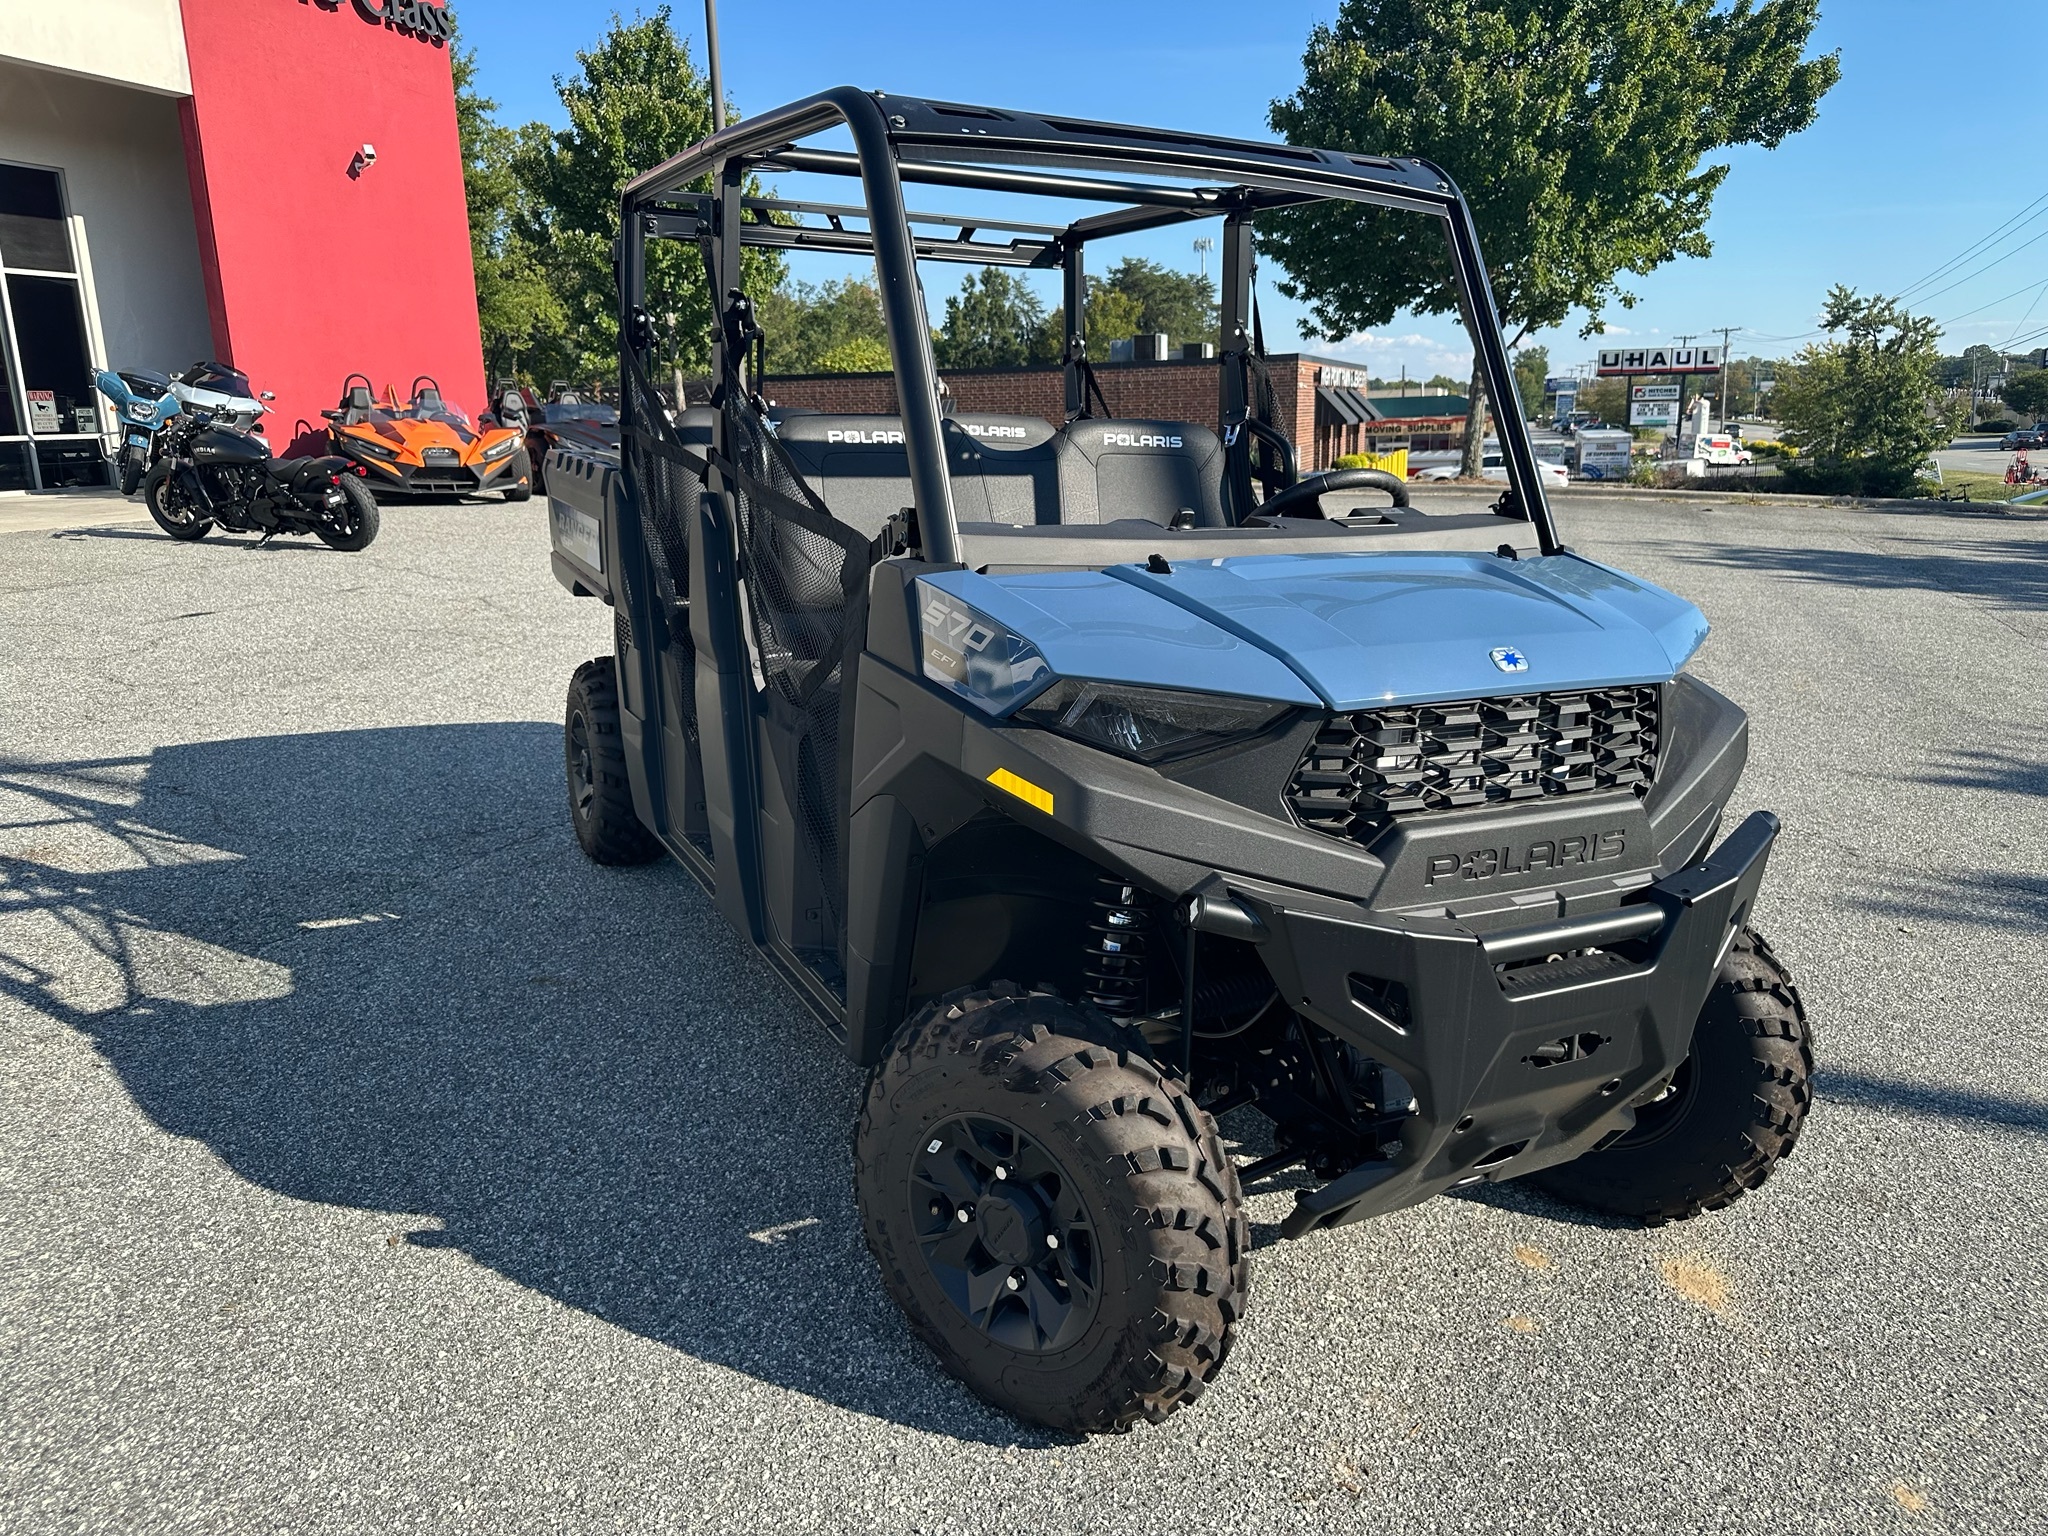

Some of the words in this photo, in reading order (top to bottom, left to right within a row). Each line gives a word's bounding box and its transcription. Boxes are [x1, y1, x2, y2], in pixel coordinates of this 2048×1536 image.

[827, 430, 907, 444] POLAR
[1366, 425, 1402, 434] MOVING
[1407, 423, 1452, 433] SUPPLIES
[1103, 433, 1183, 448] POLARIS
[559, 512, 598, 550] RANGER
[922, 599, 995, 652] 570
[930, 648, 957, 668] EFI
[1424, 828, 1625, 888] POLARIS
